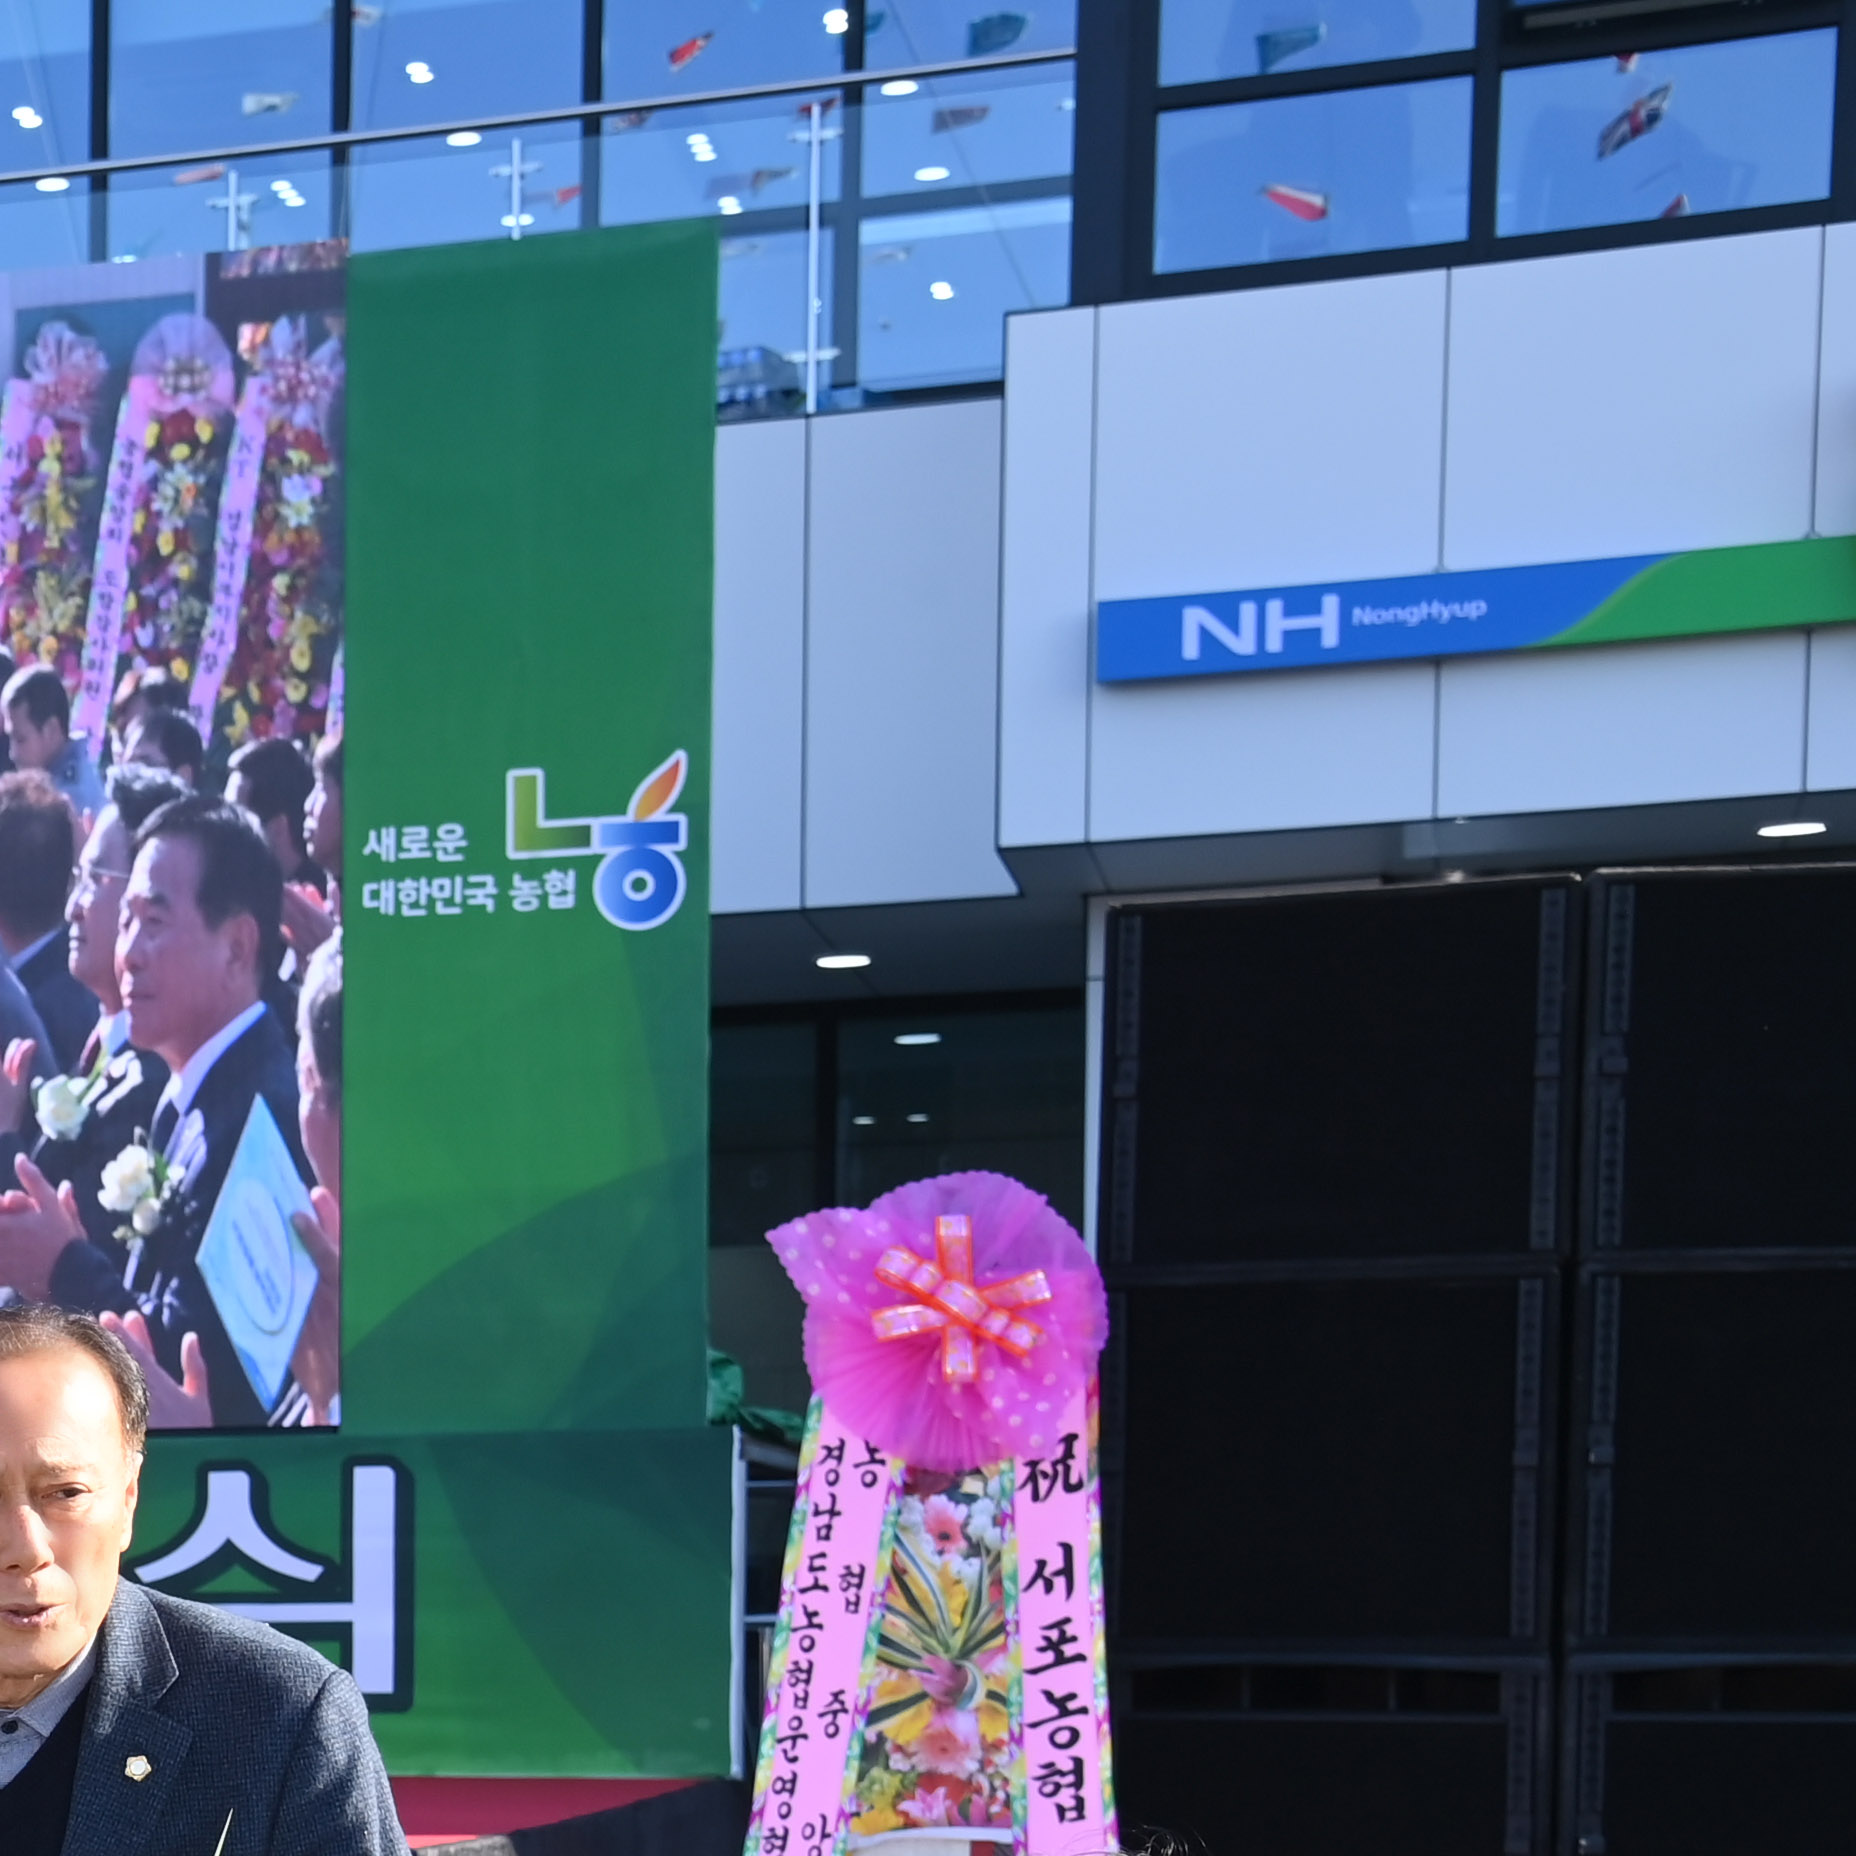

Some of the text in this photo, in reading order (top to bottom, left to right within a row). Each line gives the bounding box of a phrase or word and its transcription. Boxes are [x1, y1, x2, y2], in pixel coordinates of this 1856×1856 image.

[1181, 593, 1489, 660] NH NongHyup
[362, 822, 469, 863] 새로운
[362, 868, 577, 917] 대한민국 농협
[1016, 1433, 1085, 1503] 祝
[1021, 1541, 1090, 1823] 서포농협
